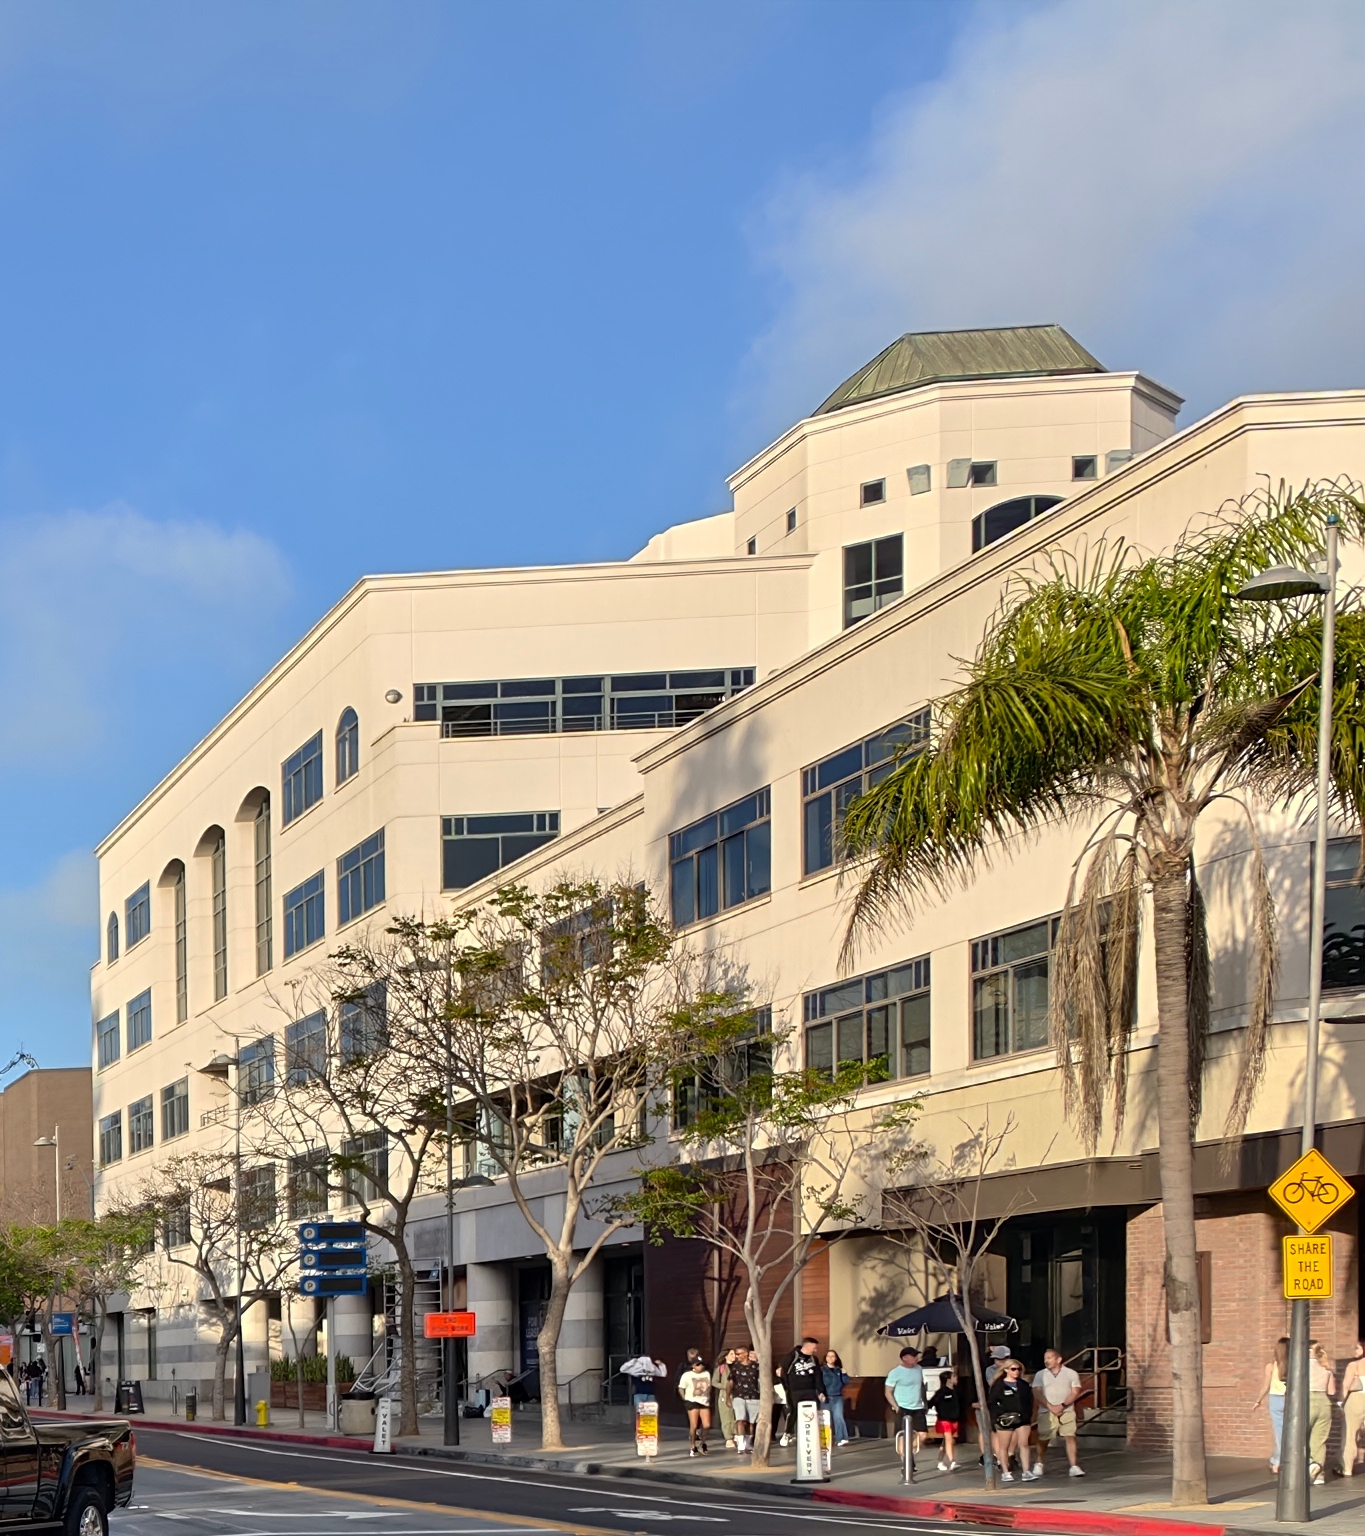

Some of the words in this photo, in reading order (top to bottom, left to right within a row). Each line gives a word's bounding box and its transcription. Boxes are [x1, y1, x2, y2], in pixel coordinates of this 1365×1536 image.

[1290, 1242, 1327, 1255] SHARE
[1298, 1261, 1320, 1272] THE
[1294, 1278, 1324, 1291] ROAD
[804, 1424, 813, 1475] DELIVERY
